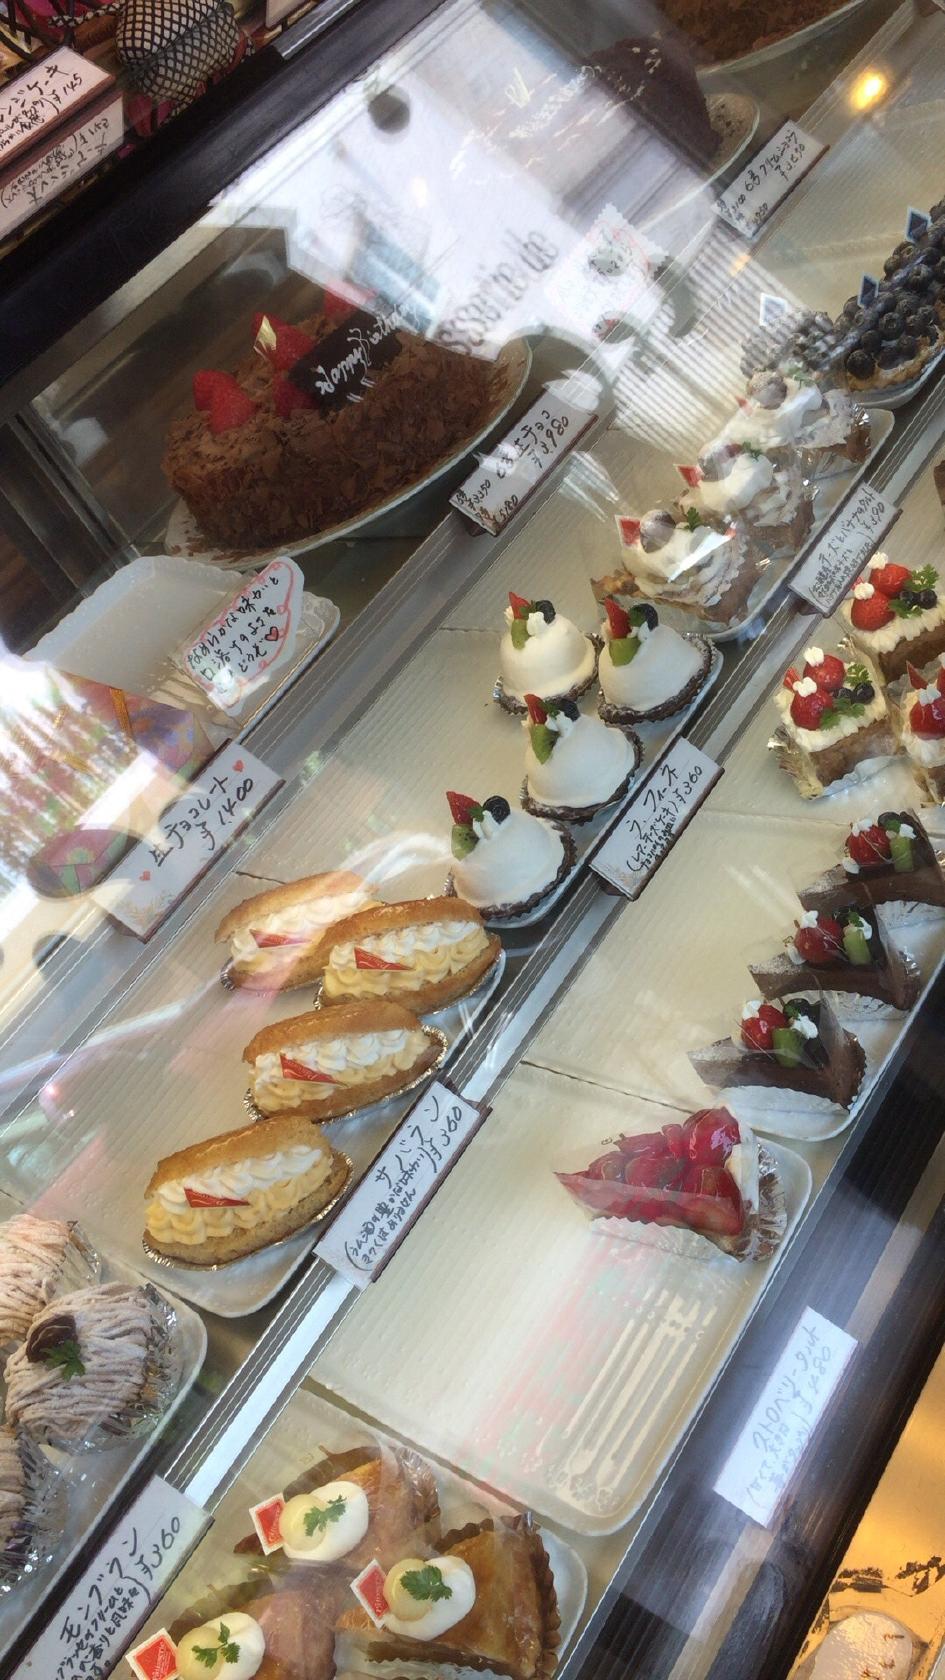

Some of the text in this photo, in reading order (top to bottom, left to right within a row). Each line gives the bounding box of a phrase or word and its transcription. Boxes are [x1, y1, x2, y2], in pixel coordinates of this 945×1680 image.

[49, 72, 83, 104] ¥145
[673, 766, 702, 804] ¥360
[149, 777, 228, 867] 生チョコレート
[375, 1096, 439, 1189] サバラン
[422, 1106, 462, 1160] ¥360
[135, 1516, 181, 1580] ¥360
[60, 1527, 137, 1643] モンブラン
